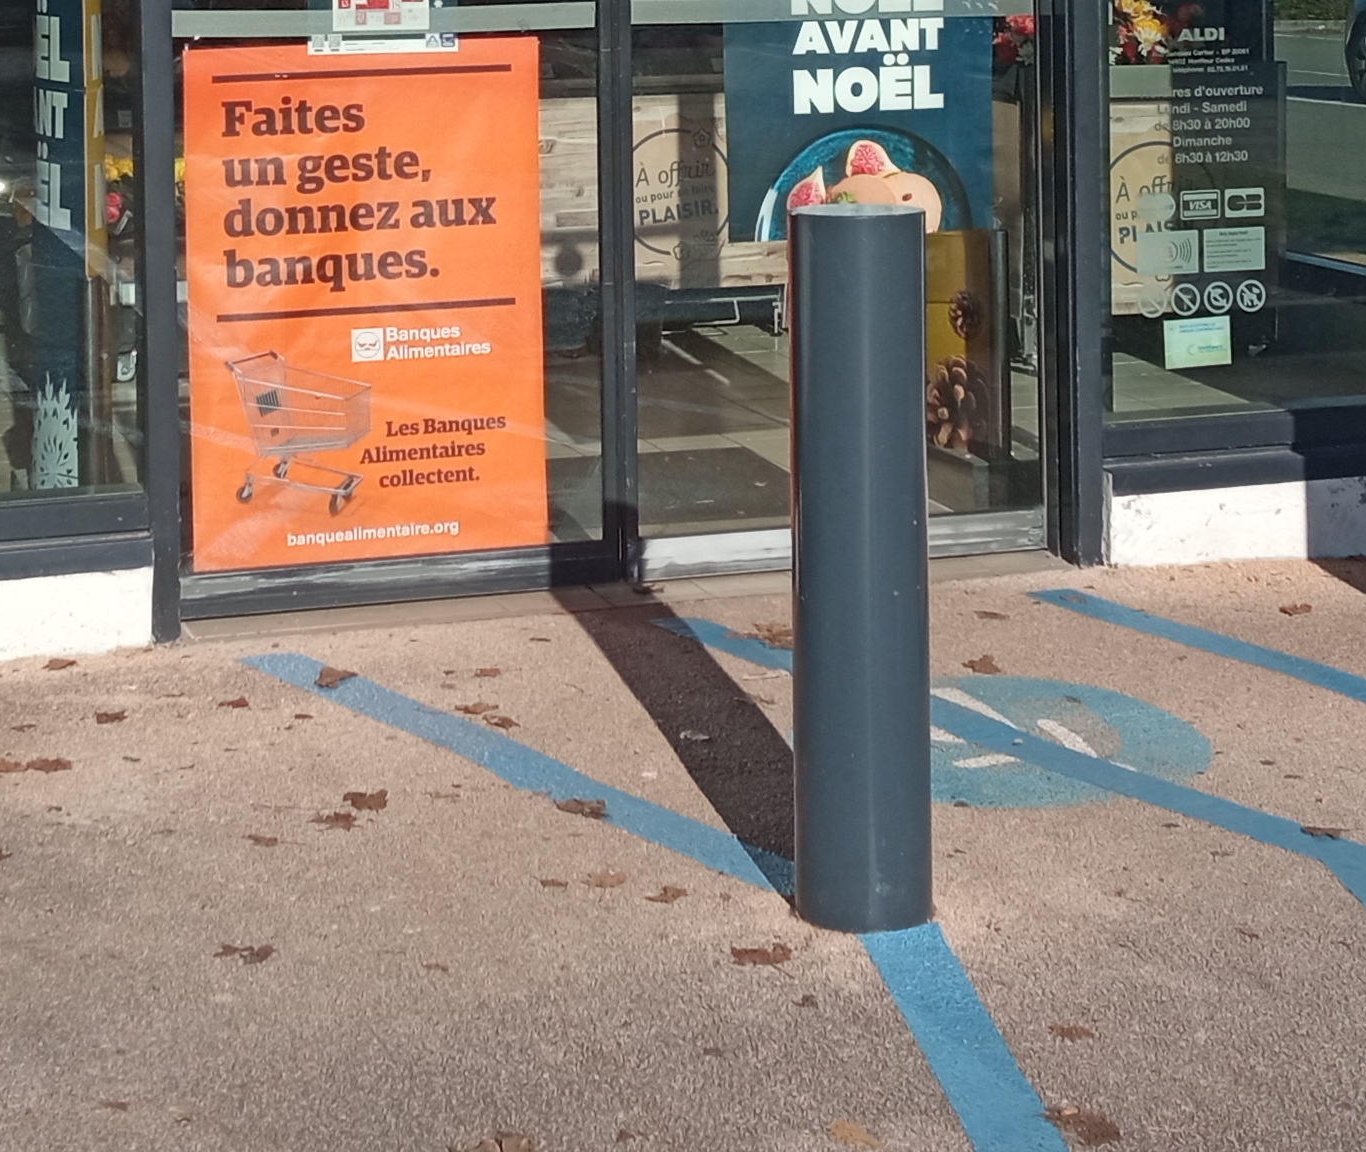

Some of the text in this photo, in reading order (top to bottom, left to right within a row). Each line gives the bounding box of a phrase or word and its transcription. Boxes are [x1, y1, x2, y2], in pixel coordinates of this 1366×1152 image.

[792, 17, 944, 55] AVANT
[1178, 27, 1225, 42] ALDI
[792, 53, 944, 114] NOËL
[1194, 85, 1264, 97] d'ouverture
[221, 96, 365, 137] Faites
[1202, 101, 1247, 113] Samedi
[1172, 119, 1201, 131] 8h30
[1204, 117, 1212, 129] à
[1215, 117, 1250, 129] 20h00
[1173, 135, 1232, 147] Dimanche
[1175, 152, 1203, 164] 8h30
[1205, 151, 1212, 163] à
[1215, 151, 1248, 162] 12h30
[222, 146, 432, 194] un geste,
[635, 161, 650, 188] À
[635, 195, 648, 203] ou
[650, 191, 674, 204] pour
[1115, 176, 1131, 204] À
[638, 200, 719, 226] PLAISIR.
[1115, 211, 1129, 220] ou
[1188, 200, 1213, 210] VISA
[224, 197, 497, 238] donnez aux
[223, 249, 440, 293] banques.
[386, 326, 461, 344] Banques
[386, 341, 491, 361] Alimentaires
[386, 415, 507, 438] Les Banques
[360, 441, 486, 464] Alimentaires
[379, 466, 480, 488] collectent.
[287, 521, 460, 547] banquealimentaire.org
